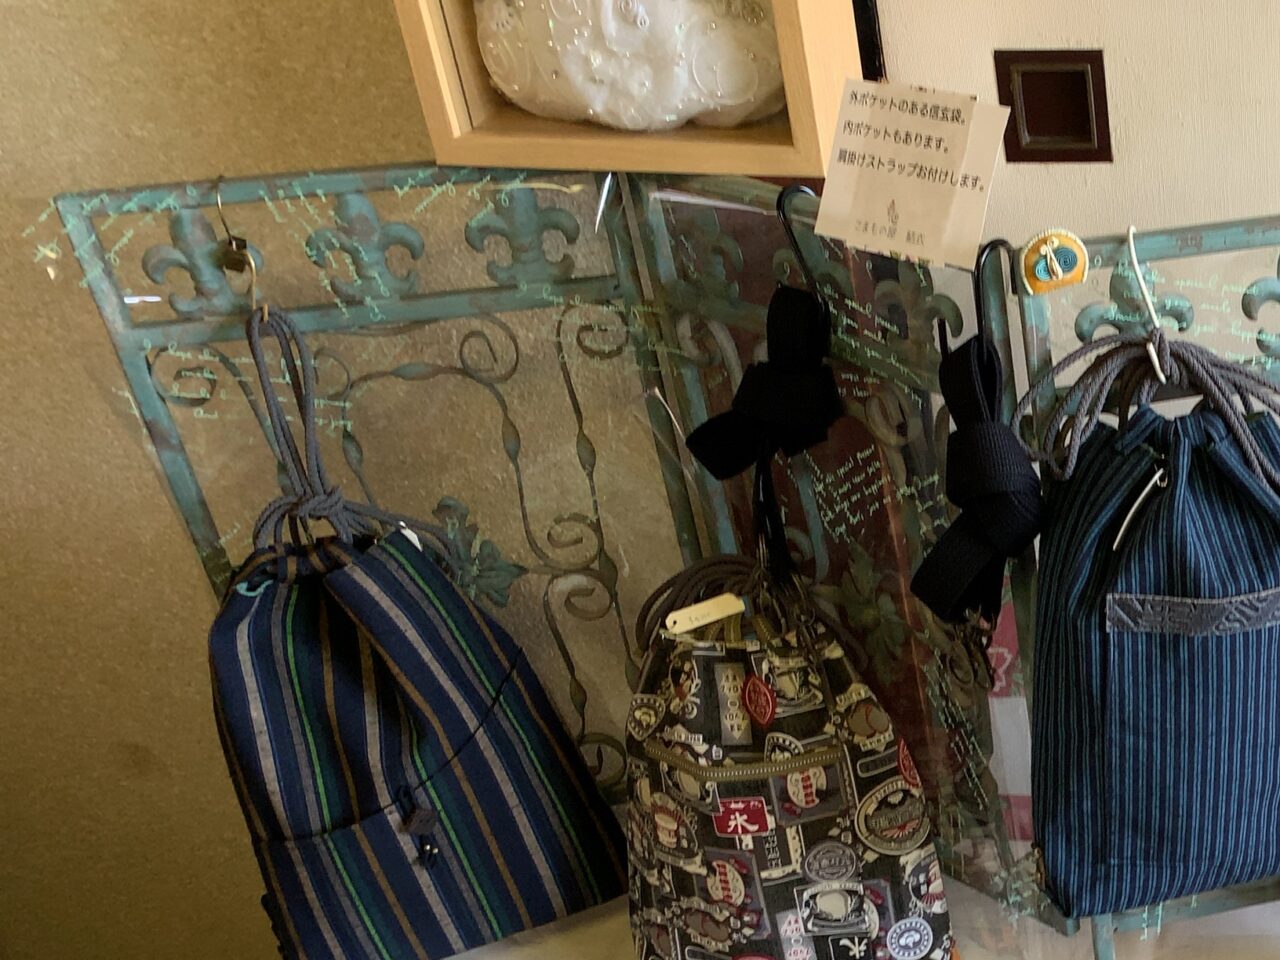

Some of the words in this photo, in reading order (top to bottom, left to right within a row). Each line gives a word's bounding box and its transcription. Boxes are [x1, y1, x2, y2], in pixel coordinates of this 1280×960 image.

[848, 89, 966, 125] 外ポケットのある信玄袋。
[842, 121, 949, 153] 内ポケットもあります。
[836, 148, 985, 192] 肩掛けストラップお付けします。
[727, 811, 760, 834] 氷
